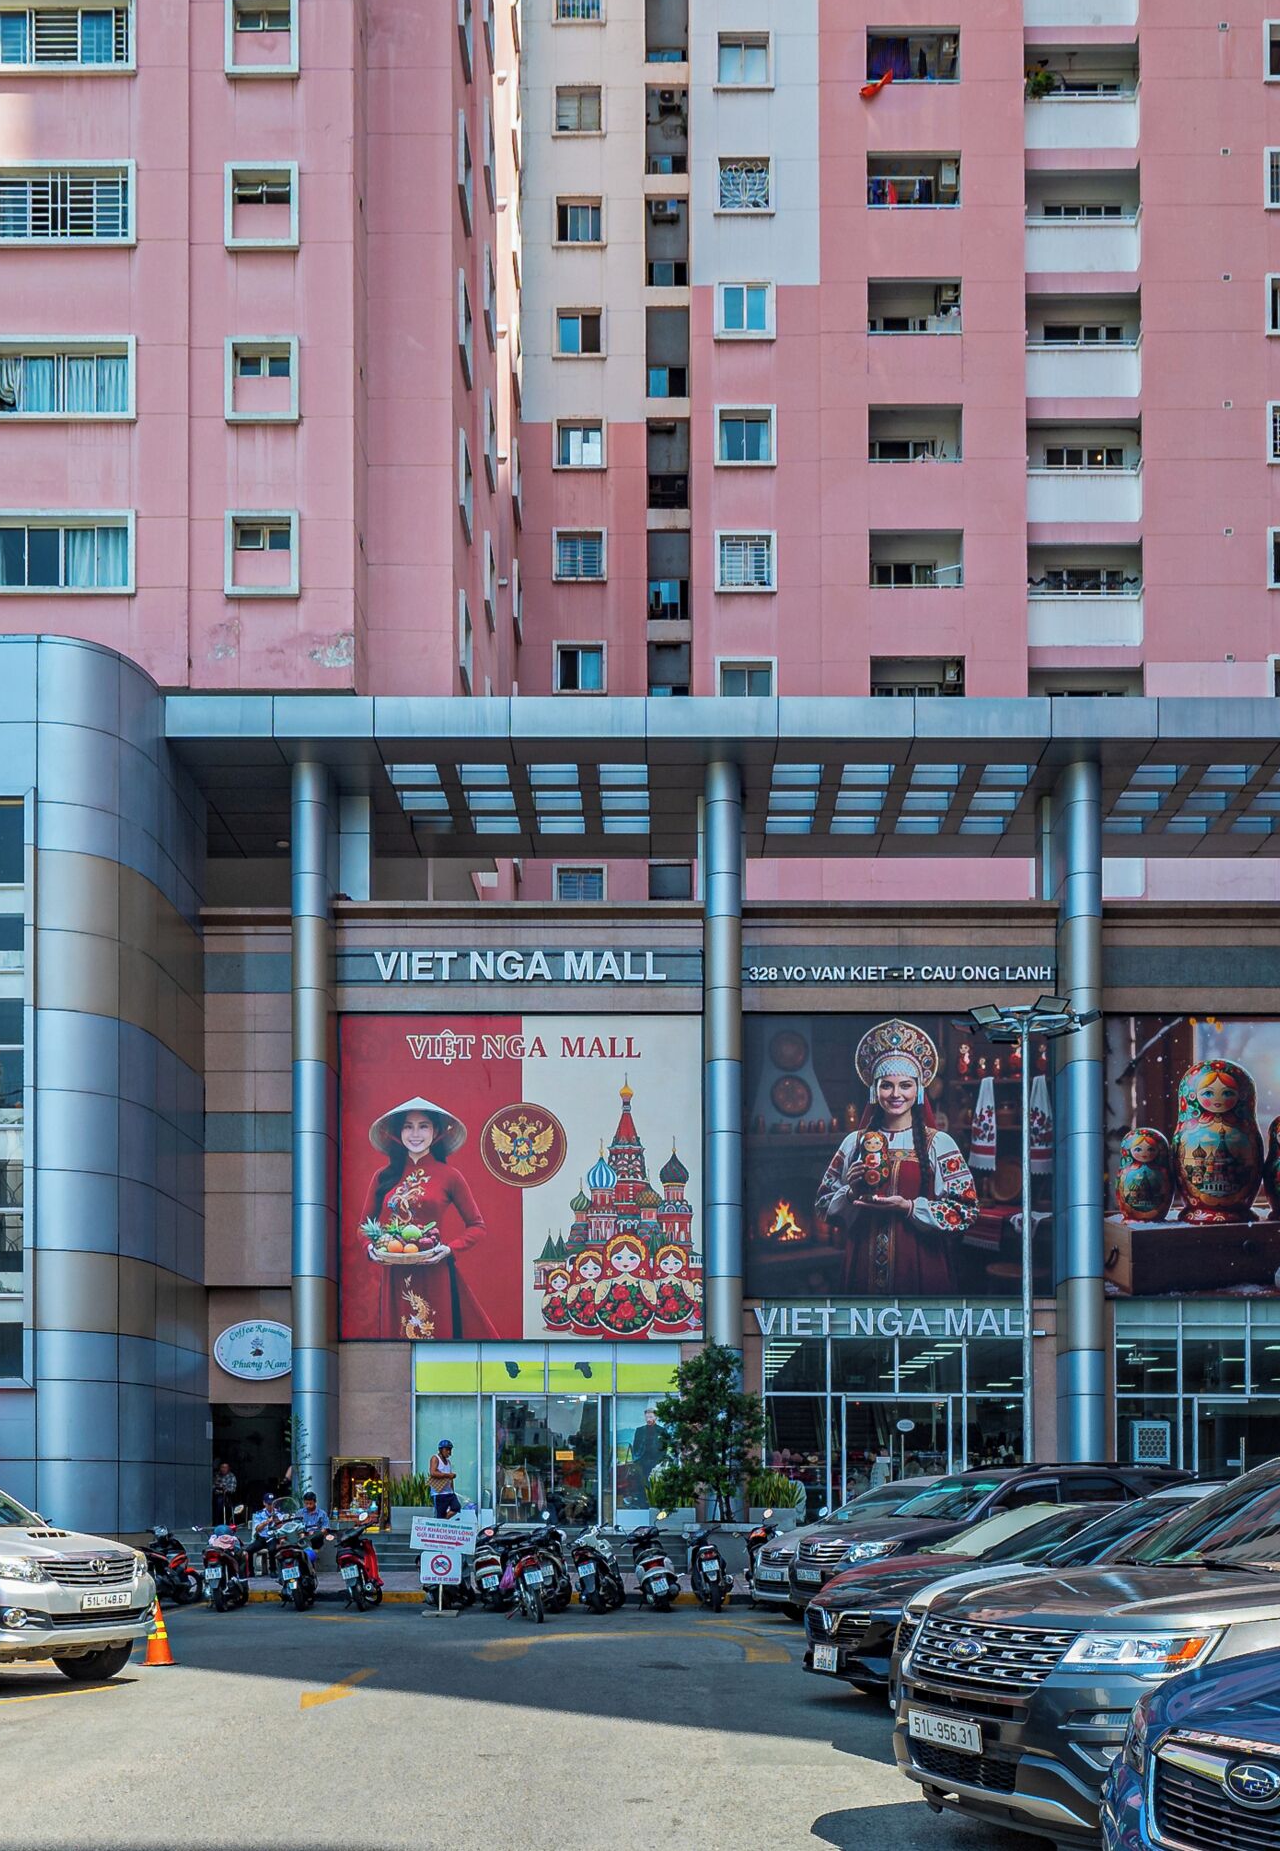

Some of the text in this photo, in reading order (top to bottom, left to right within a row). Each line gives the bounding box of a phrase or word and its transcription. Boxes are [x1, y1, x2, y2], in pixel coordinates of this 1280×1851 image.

[373, 951, 667, 981] VIET NGA MALL
[749, 966, 778, 981] 328
[782, 966, 806, 981] VO
[811, 966, 845, 981] VAN
[850, 966, 888, 981] KIET
[903, 966, 915, 981] P.
[921, 966, 957, 981] CAU
[961, 966, 1000, 981] ONG
[1005, 966, 1051, 981] LANH
[406, 1028, 642, 1065] VIỆT NGA MALL
[229, 1326, 255, 1341] Coffee
[754, 1307, 836, 1336] VIET
[850, 1307, 931, 1336] NGA
[265, 1359, 287, 1368] Nam
[914, 1716, 973, 1747] 51L-956.31
